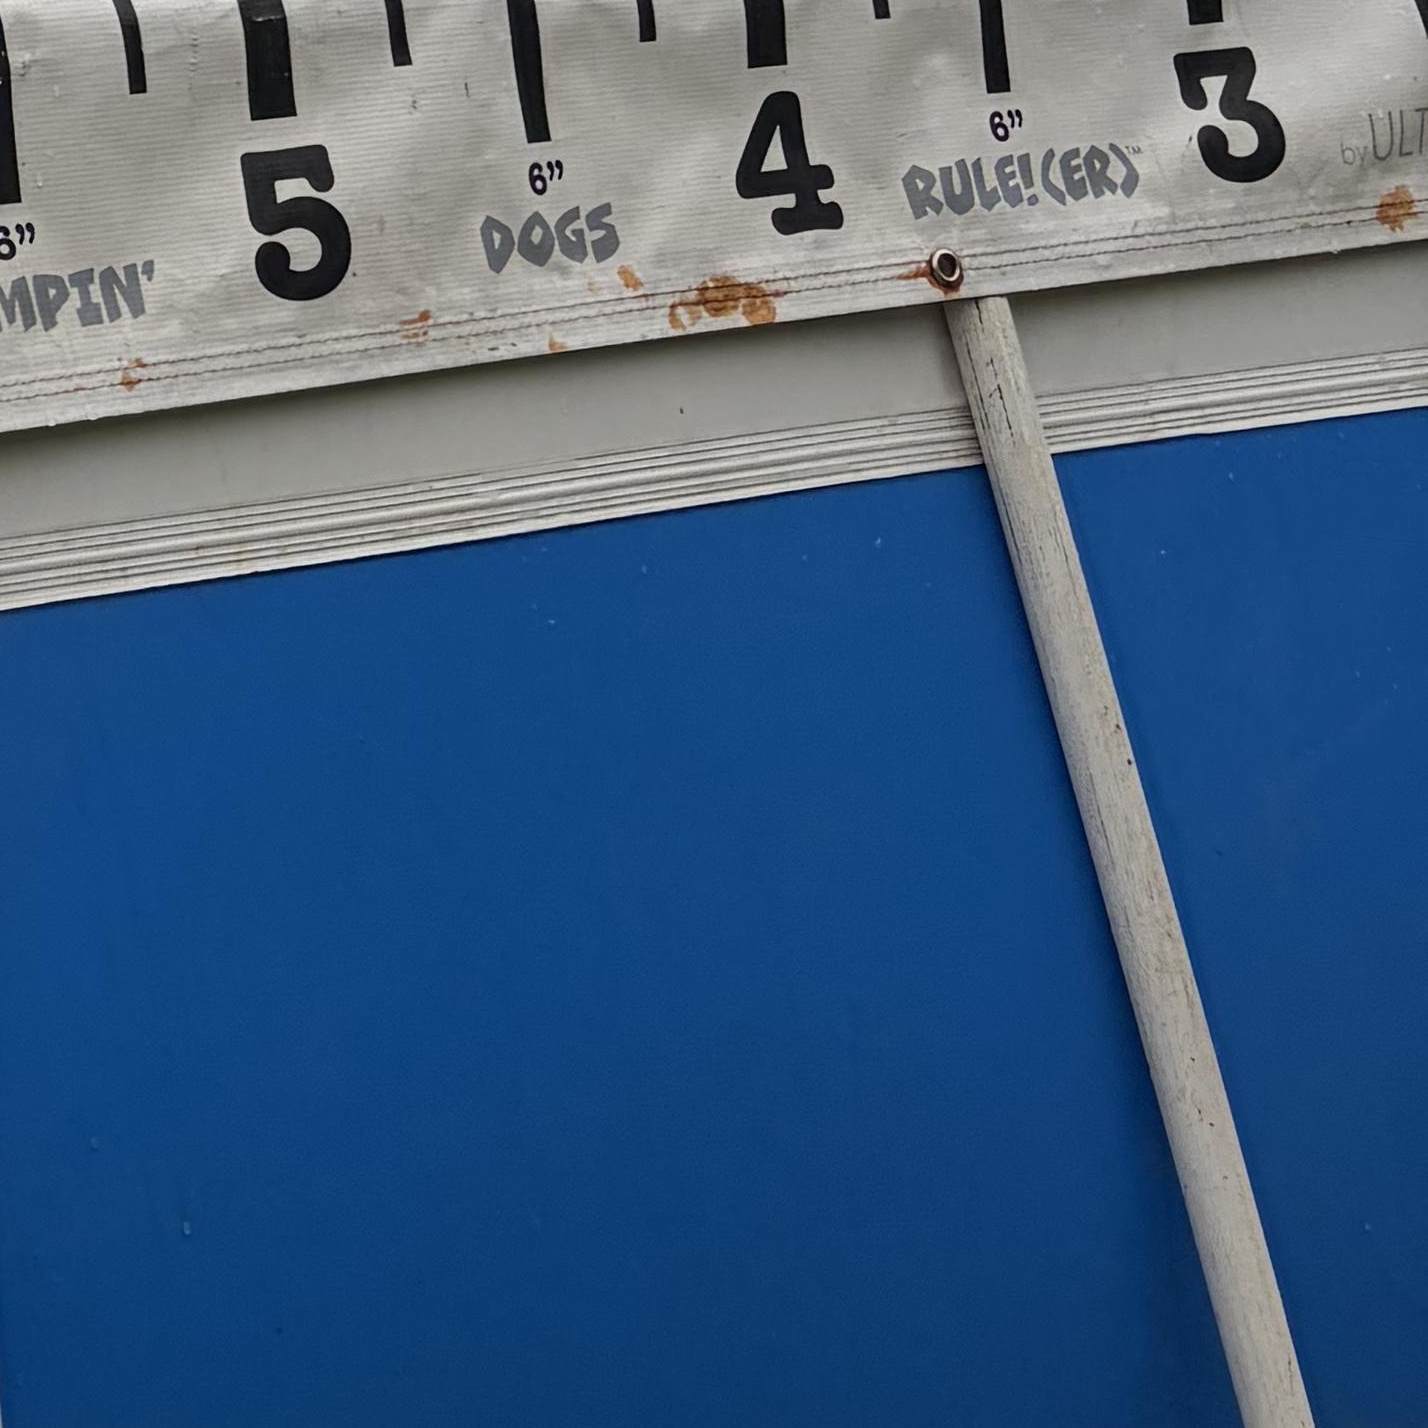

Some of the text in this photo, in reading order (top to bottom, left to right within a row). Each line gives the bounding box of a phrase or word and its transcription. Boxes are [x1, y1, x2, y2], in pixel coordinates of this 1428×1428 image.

[735, 90, 844, 236] 4
[1173, 46, 1286, 183] 3
[240, 144, 352, 302] 5
[479, 201, 621, 275] DOGS
